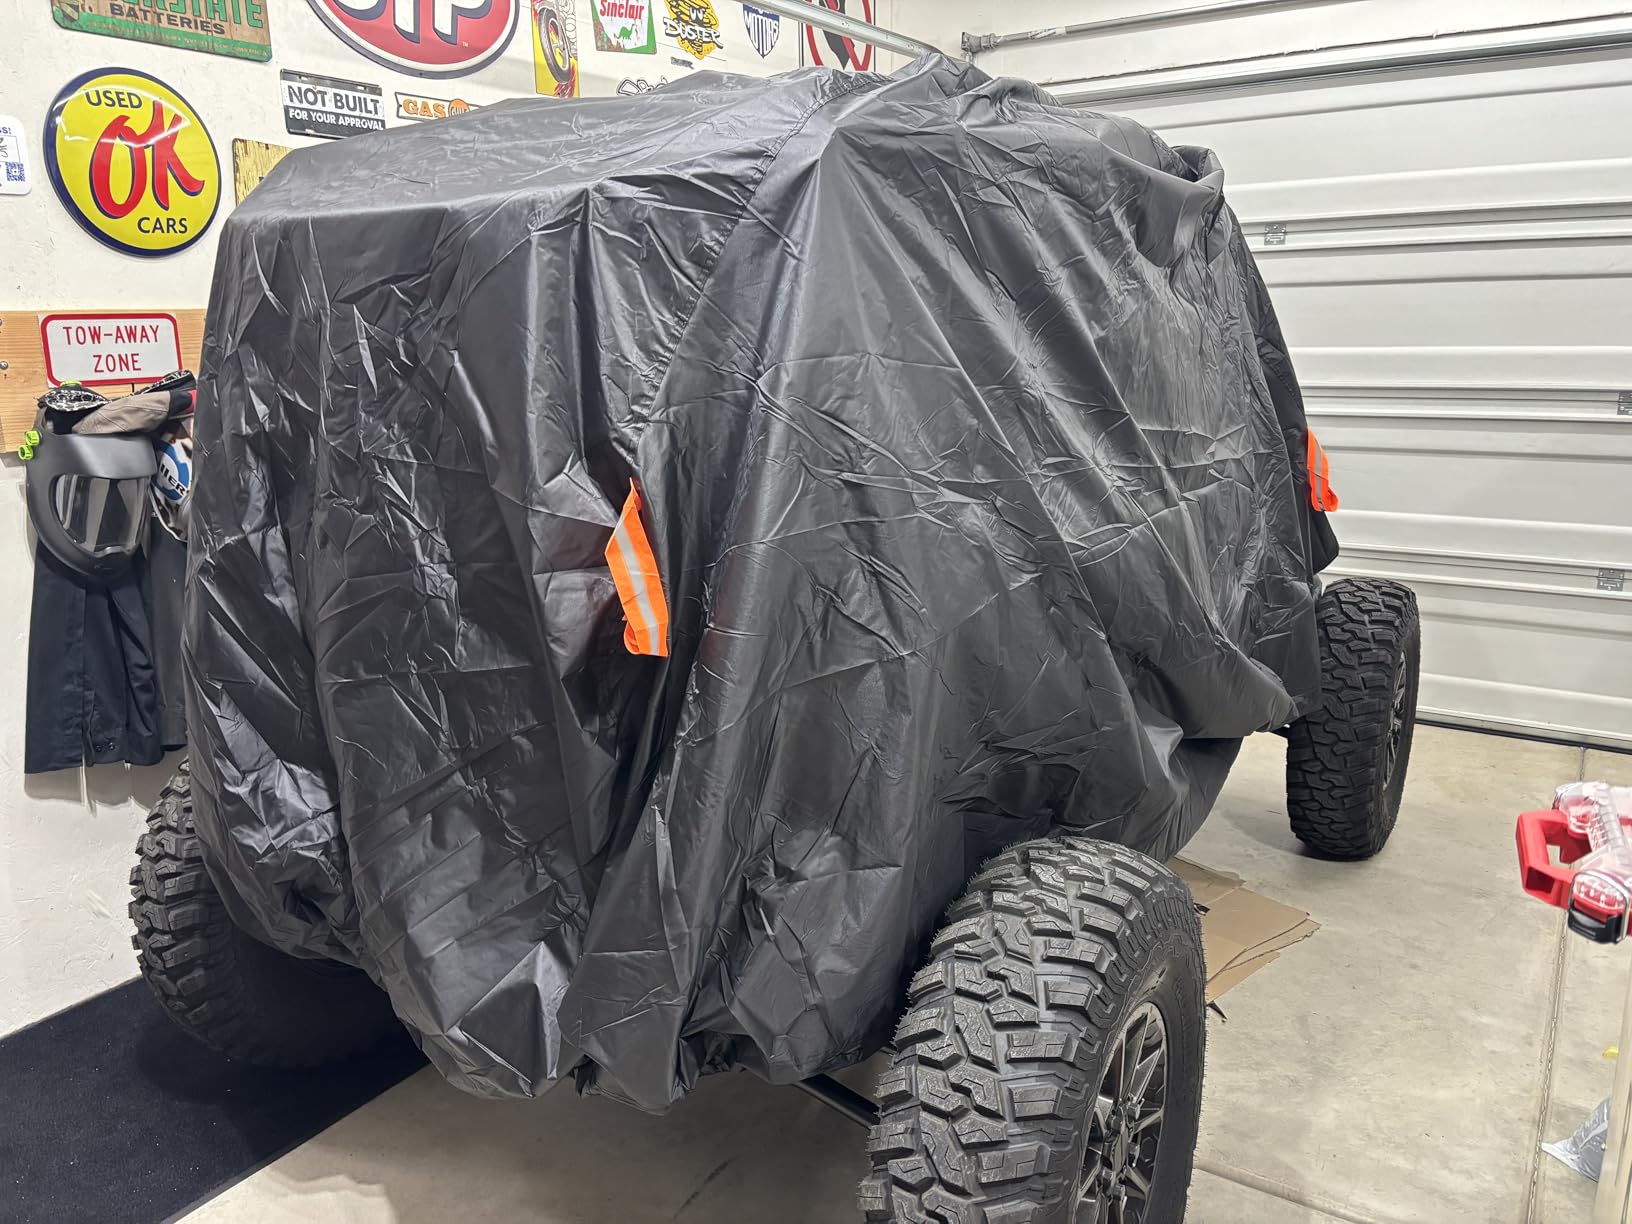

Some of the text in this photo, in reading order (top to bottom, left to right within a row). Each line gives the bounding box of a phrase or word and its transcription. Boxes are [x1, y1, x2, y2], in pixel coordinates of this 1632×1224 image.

[110, 3, 225, 35] BATTERIES
[600, 0, 644, 19] Sinclair
[663, 17, 723, 49] DUSTER
[744, 10, 778, 55] MOTORS
[85, 90, 143, 109] USED
[287, 84, 380, 116] NOT BUILT
[403, 98, 447, 119] GAS
[288, 110, 384, 131] FOR YOUR APPROVAL
[89, 100, 205, 219] OK
[137, 216, 188, 234] CARS
[62, 324, 160, 346] TOW-AWAY
[93, 353, 142, 373] ZONE
